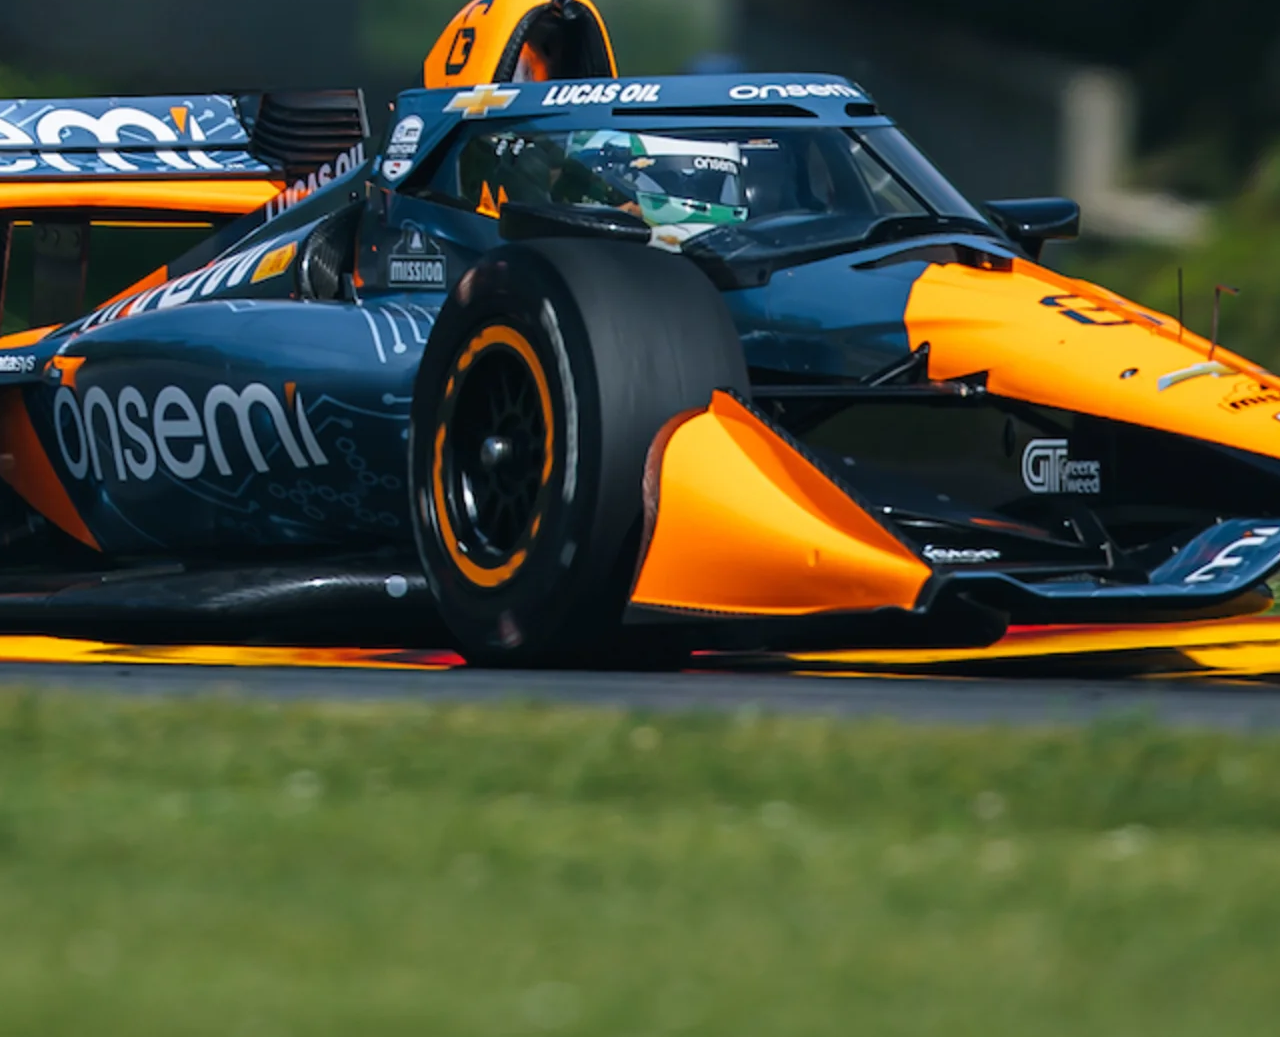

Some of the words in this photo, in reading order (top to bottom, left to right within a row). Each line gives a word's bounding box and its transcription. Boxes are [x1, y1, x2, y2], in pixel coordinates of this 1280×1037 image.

[541, 83, 621, 106] LUCAS
[619, 83, 661, 103] OIL
[53, 381, 329, 481] onsemi
